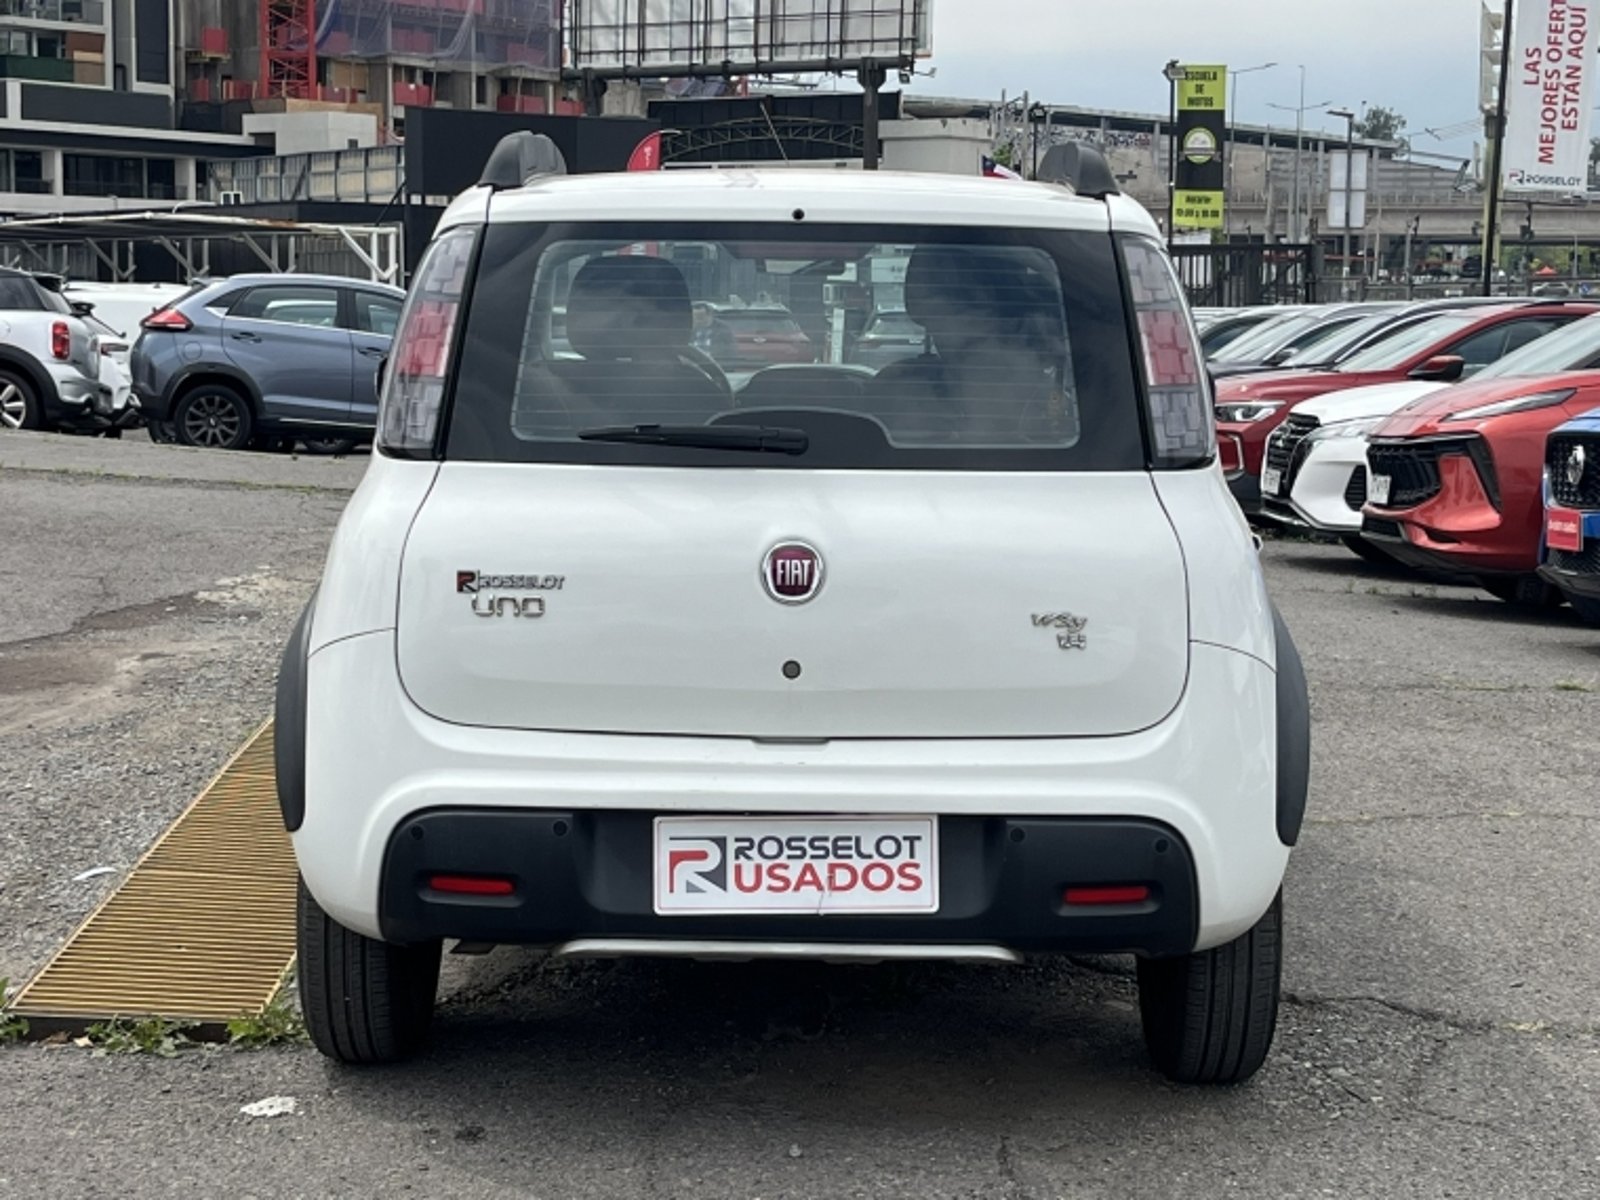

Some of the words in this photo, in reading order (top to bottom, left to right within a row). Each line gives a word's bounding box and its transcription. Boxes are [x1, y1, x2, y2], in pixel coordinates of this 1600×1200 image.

[1566, 4, 1588, 60] AQUÍ
[1523, 47, 1542, 85] LAS
[1538, 69, 1562, 164] MEJORES
[1559, 65, 1583, 131] ESTÁN
[776, 559, 811, 586] FIAT
[734, 835, 923, 860] ROSSELOT
[734, 862, 924, 893] USADOS
